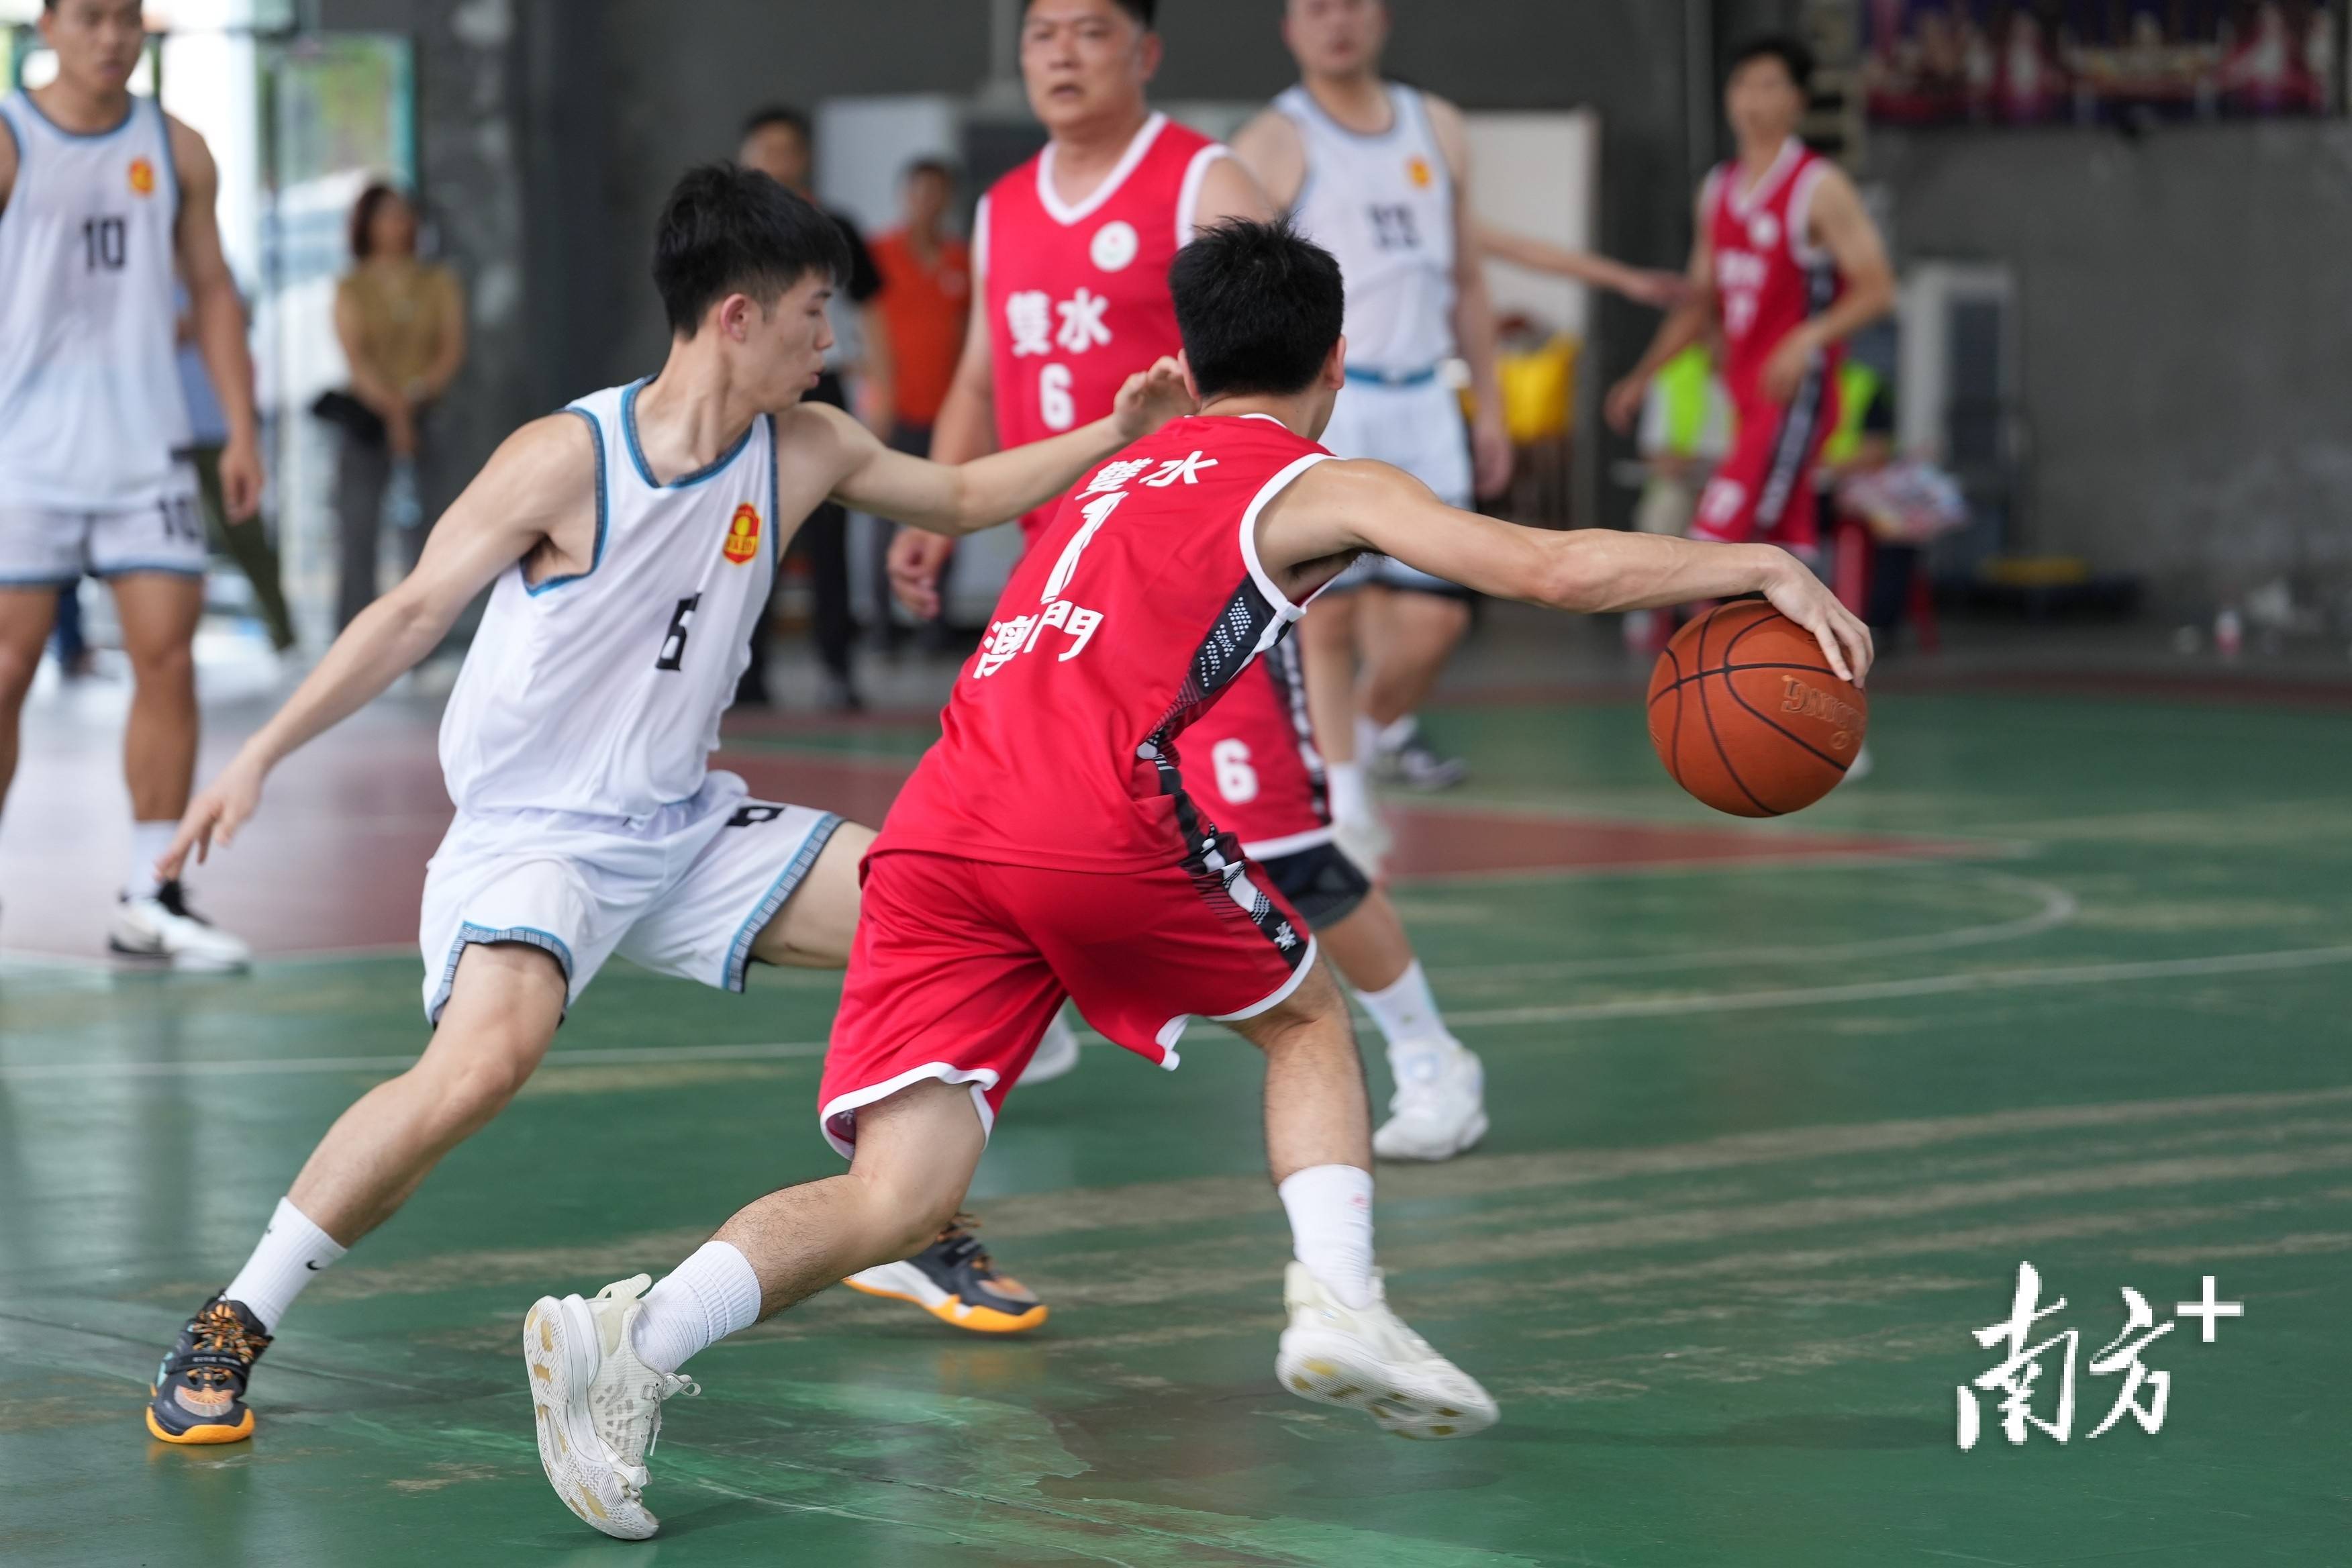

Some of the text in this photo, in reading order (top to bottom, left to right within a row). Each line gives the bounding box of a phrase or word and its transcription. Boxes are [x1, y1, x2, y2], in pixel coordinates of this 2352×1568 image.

[82, 215, 126, 273] 10
[1039, 362, 1075, 432] 6
[1074, 450, 1218, 501] 雙水
[655, 593, 701, 672] 6
[973, 600, 1104, 679] 澳門
[1211, 738, 1260, 805] 6
